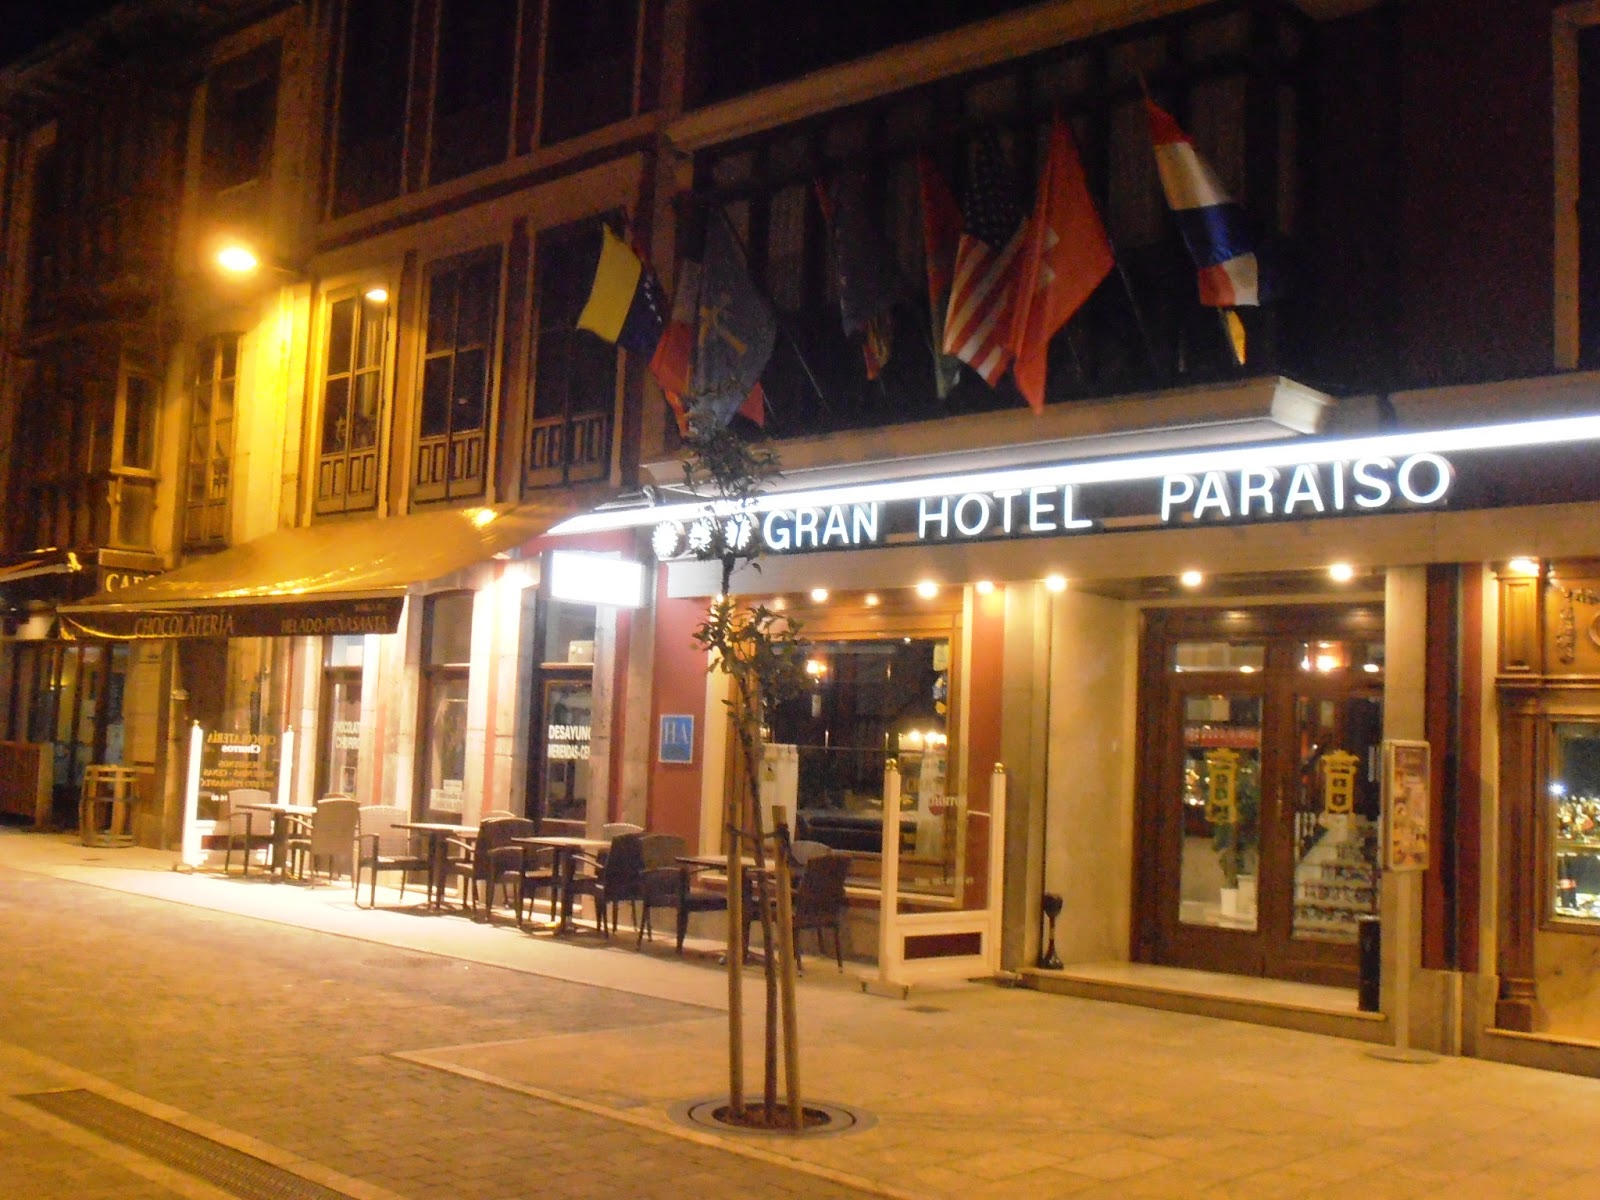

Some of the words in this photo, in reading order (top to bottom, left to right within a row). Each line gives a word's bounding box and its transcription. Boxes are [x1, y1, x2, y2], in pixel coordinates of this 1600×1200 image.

[762, 501, 878, 550] GRAN
[918, 484, 1093, 539] HOTEL
[1160, 452, 1451, 522] PARAISO
